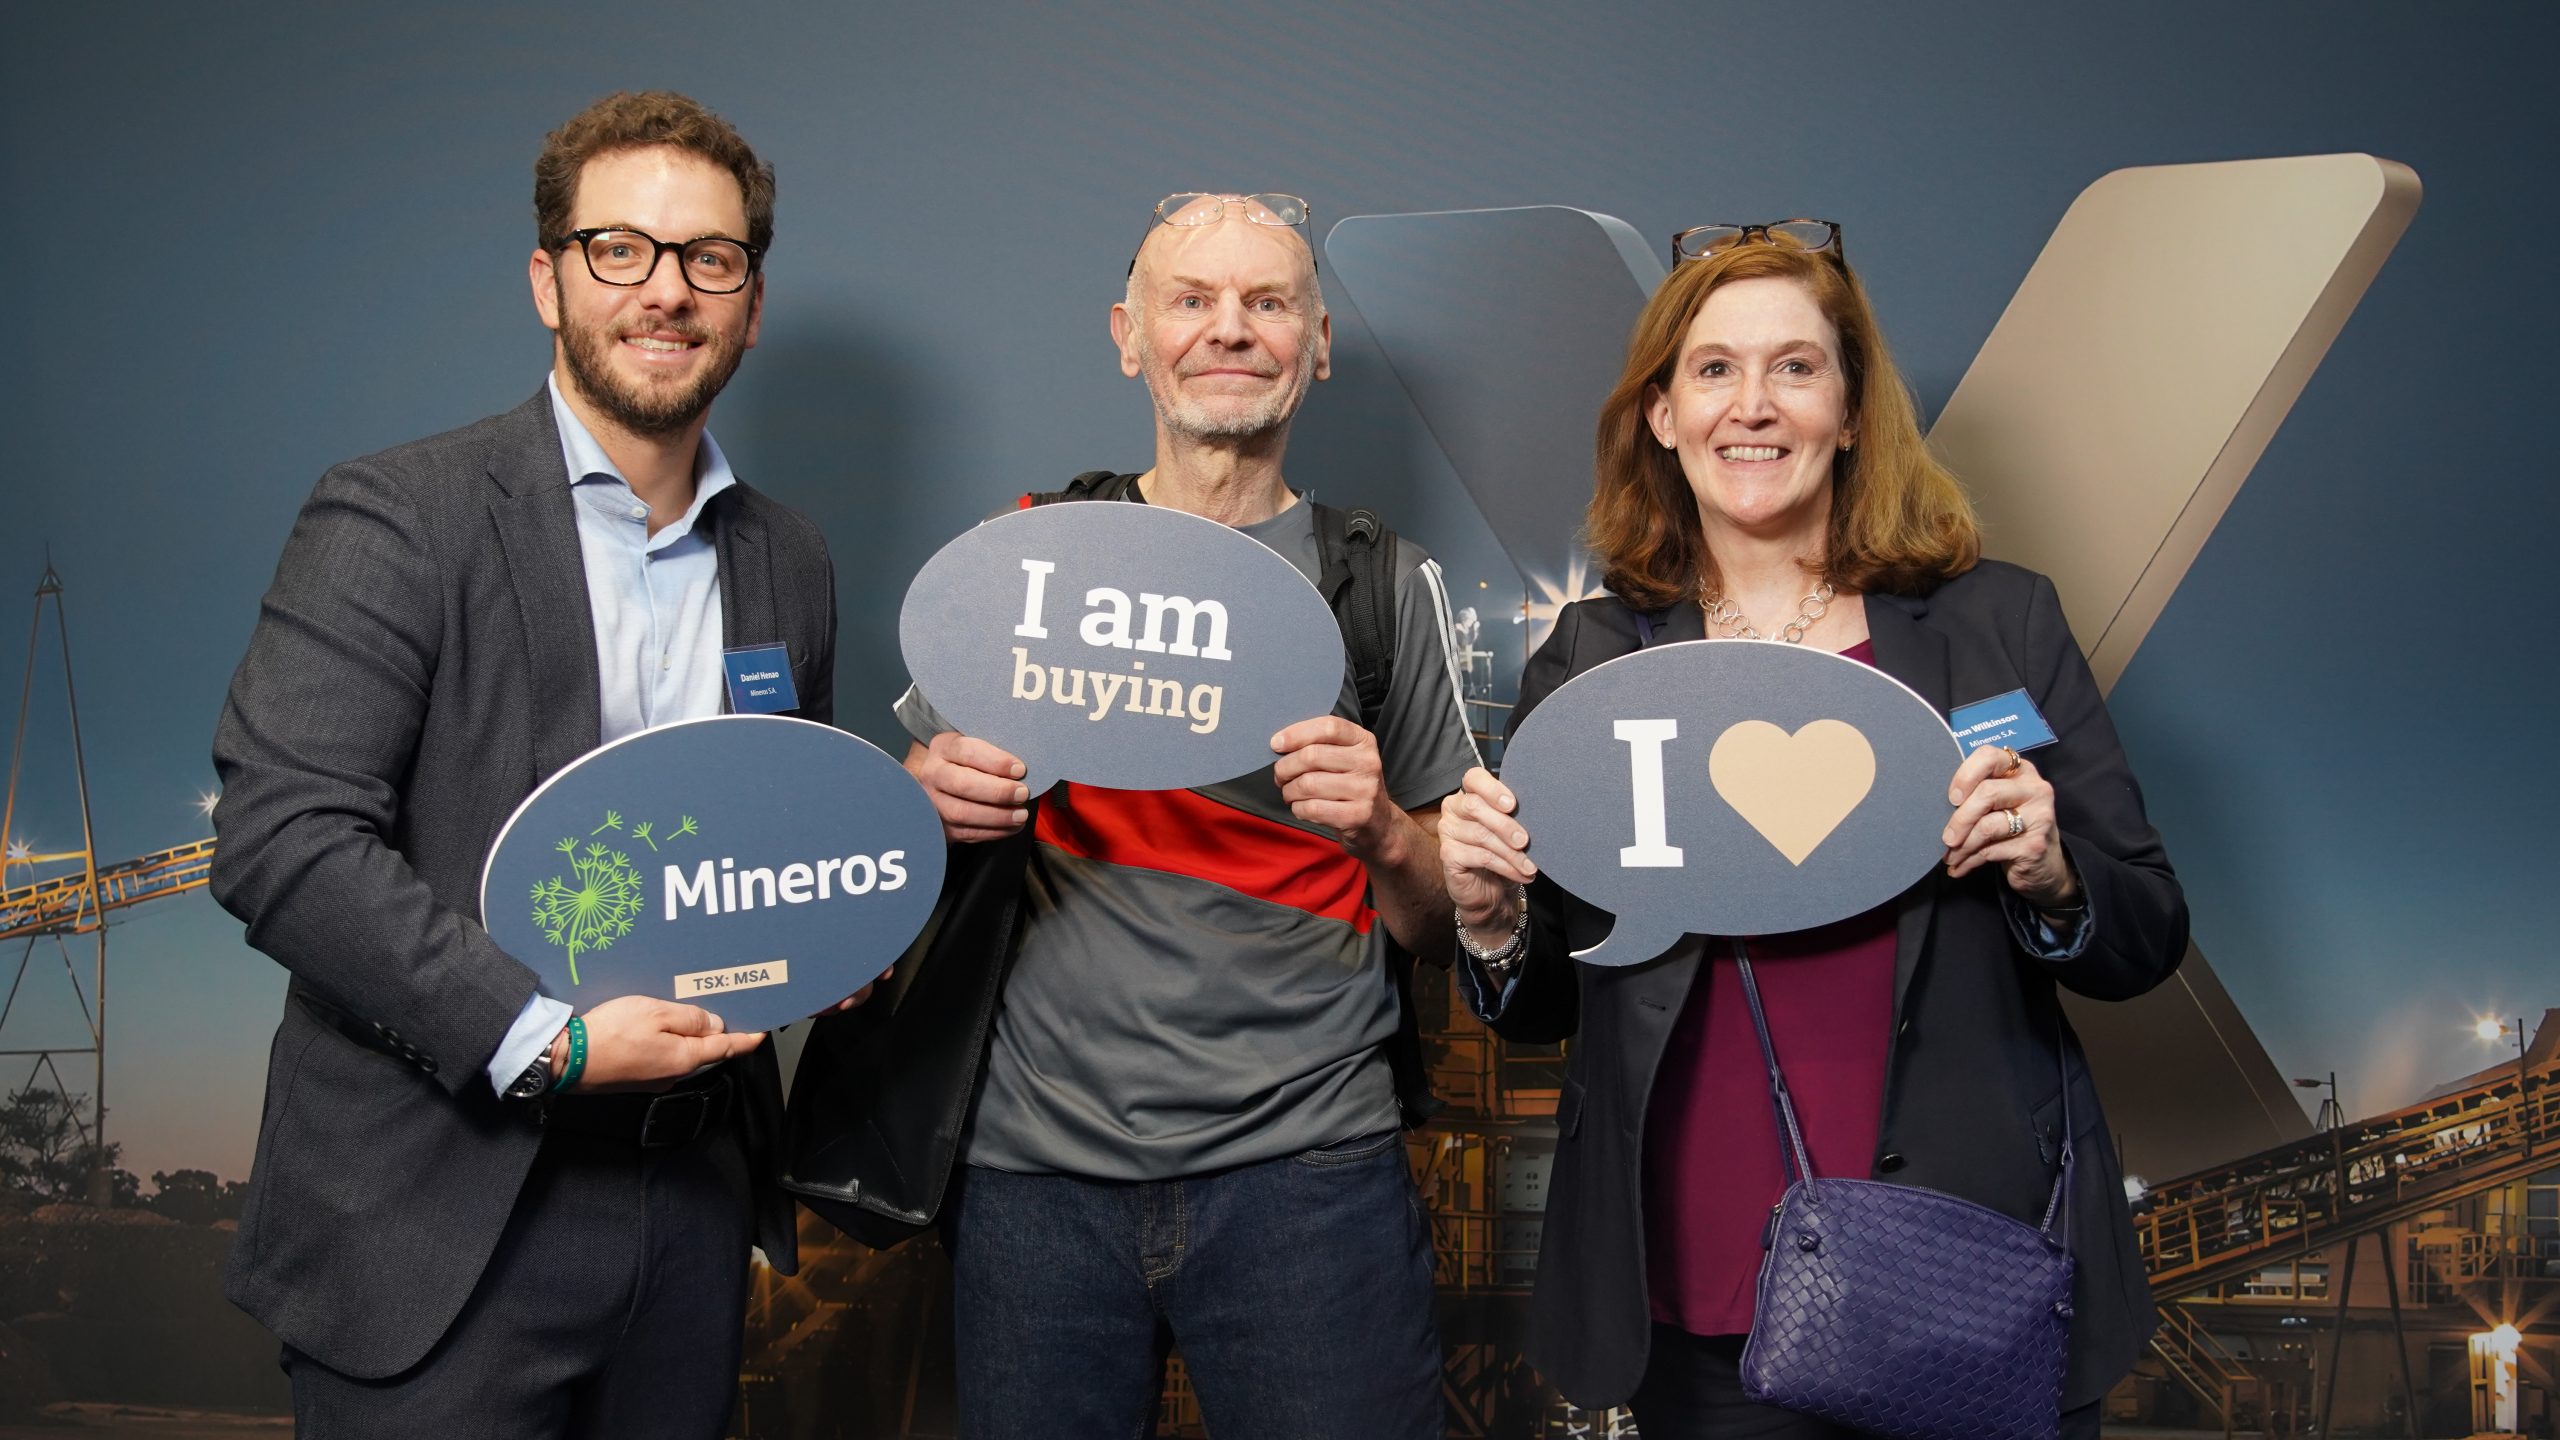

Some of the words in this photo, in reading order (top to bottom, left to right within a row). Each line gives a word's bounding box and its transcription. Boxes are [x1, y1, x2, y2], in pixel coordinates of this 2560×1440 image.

[1014, 558, 1056, 640] I
[1079, 587, 1232, 662] am
[740, 673, 760, 683] Daniel
[760, 671, 780, 681] Henao
[750, 688, 768, 697] Mineros
[1011, 646, 1223, 735] buying
[1952, 728, 1972, 739] Ann
[1971, 713, 2019, 733] Wilkinson
[1969, 733, 2001, 749] Mineros
[2001, 729, 2017, 739] S.A.
[1613, 718, 1684, 868] I
[664, 849, 908, 921] Mineros
[693, 975, 730, 992] TSX:
[733, 968, 770, 986] MSA
